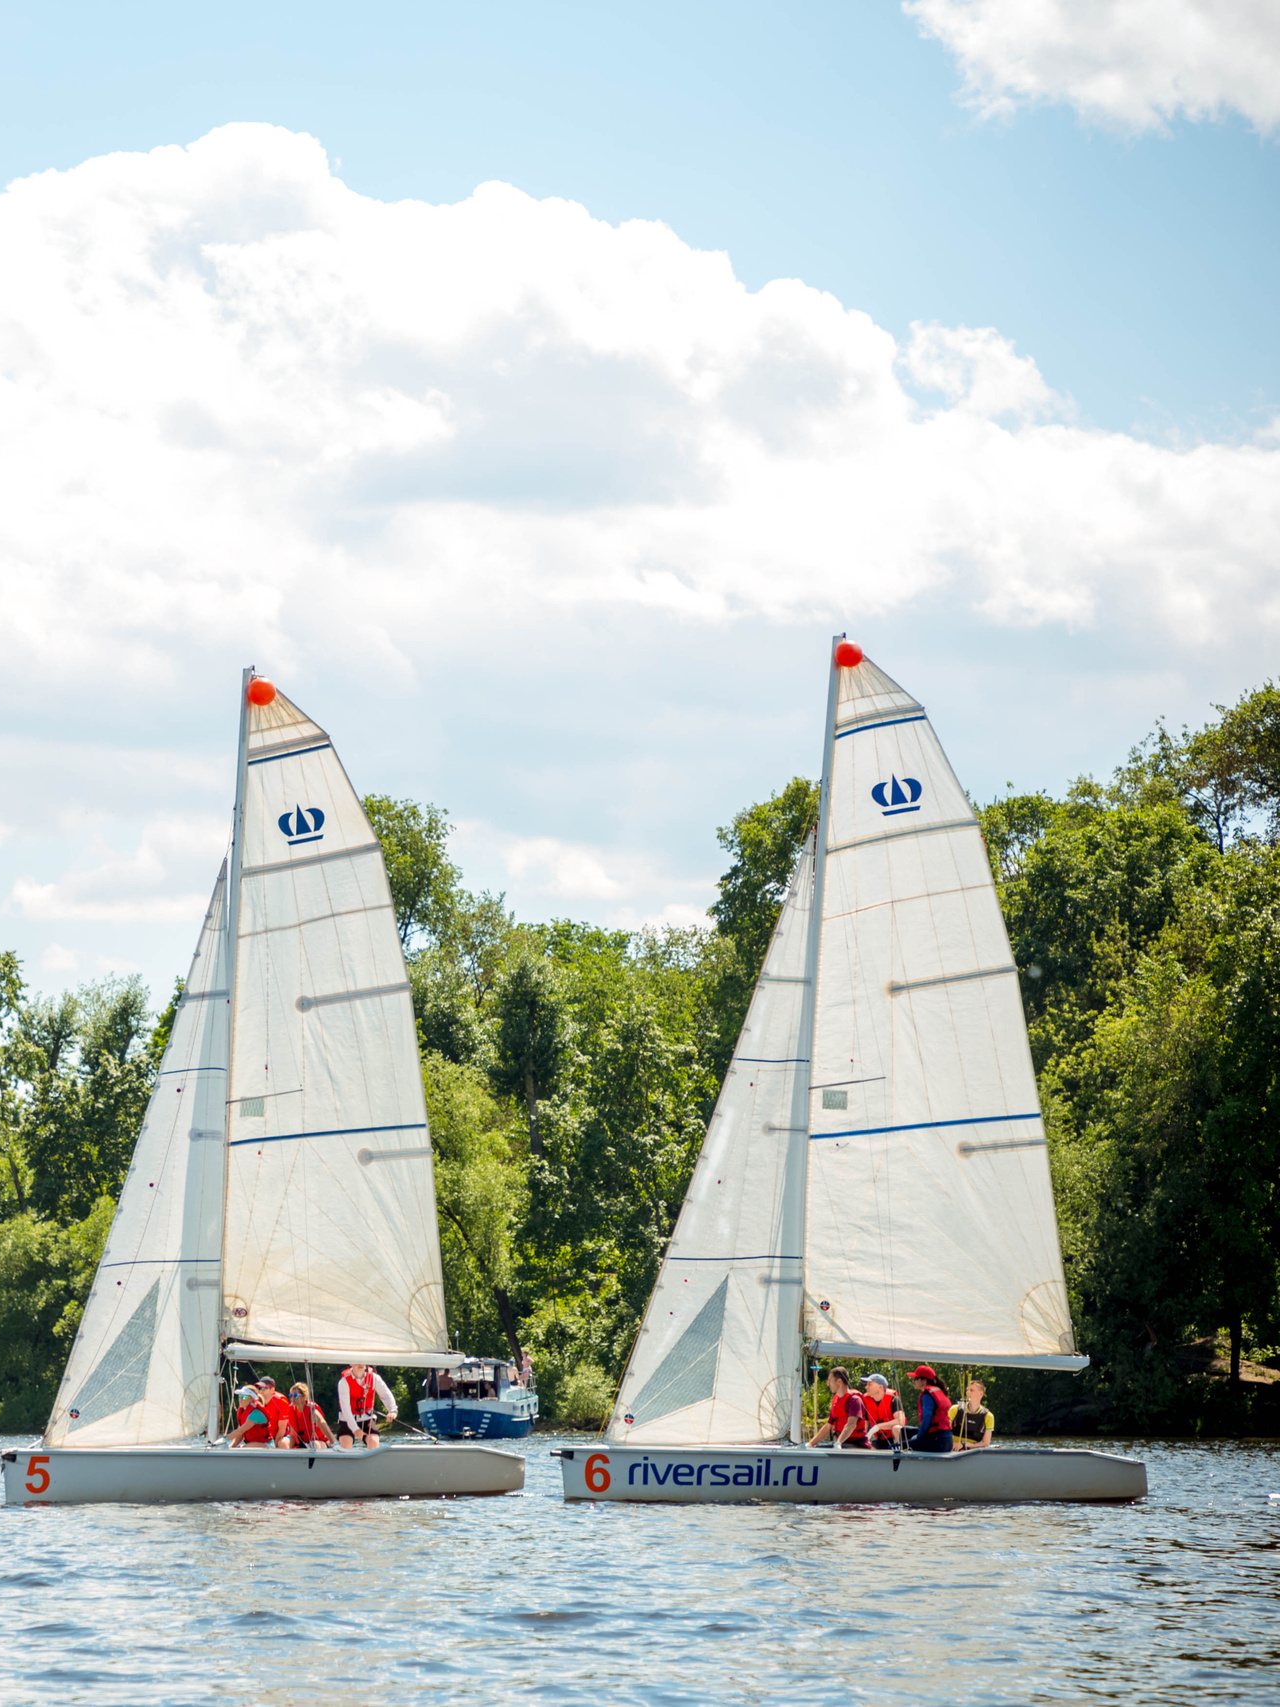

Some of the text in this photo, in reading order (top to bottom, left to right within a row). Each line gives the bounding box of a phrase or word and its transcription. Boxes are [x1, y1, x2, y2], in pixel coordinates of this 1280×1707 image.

[25, 1456, 51, 1494] 5
[584, 1453, 611, 1493] 6
[628, 1456, 819, 1487] riversail.ru
